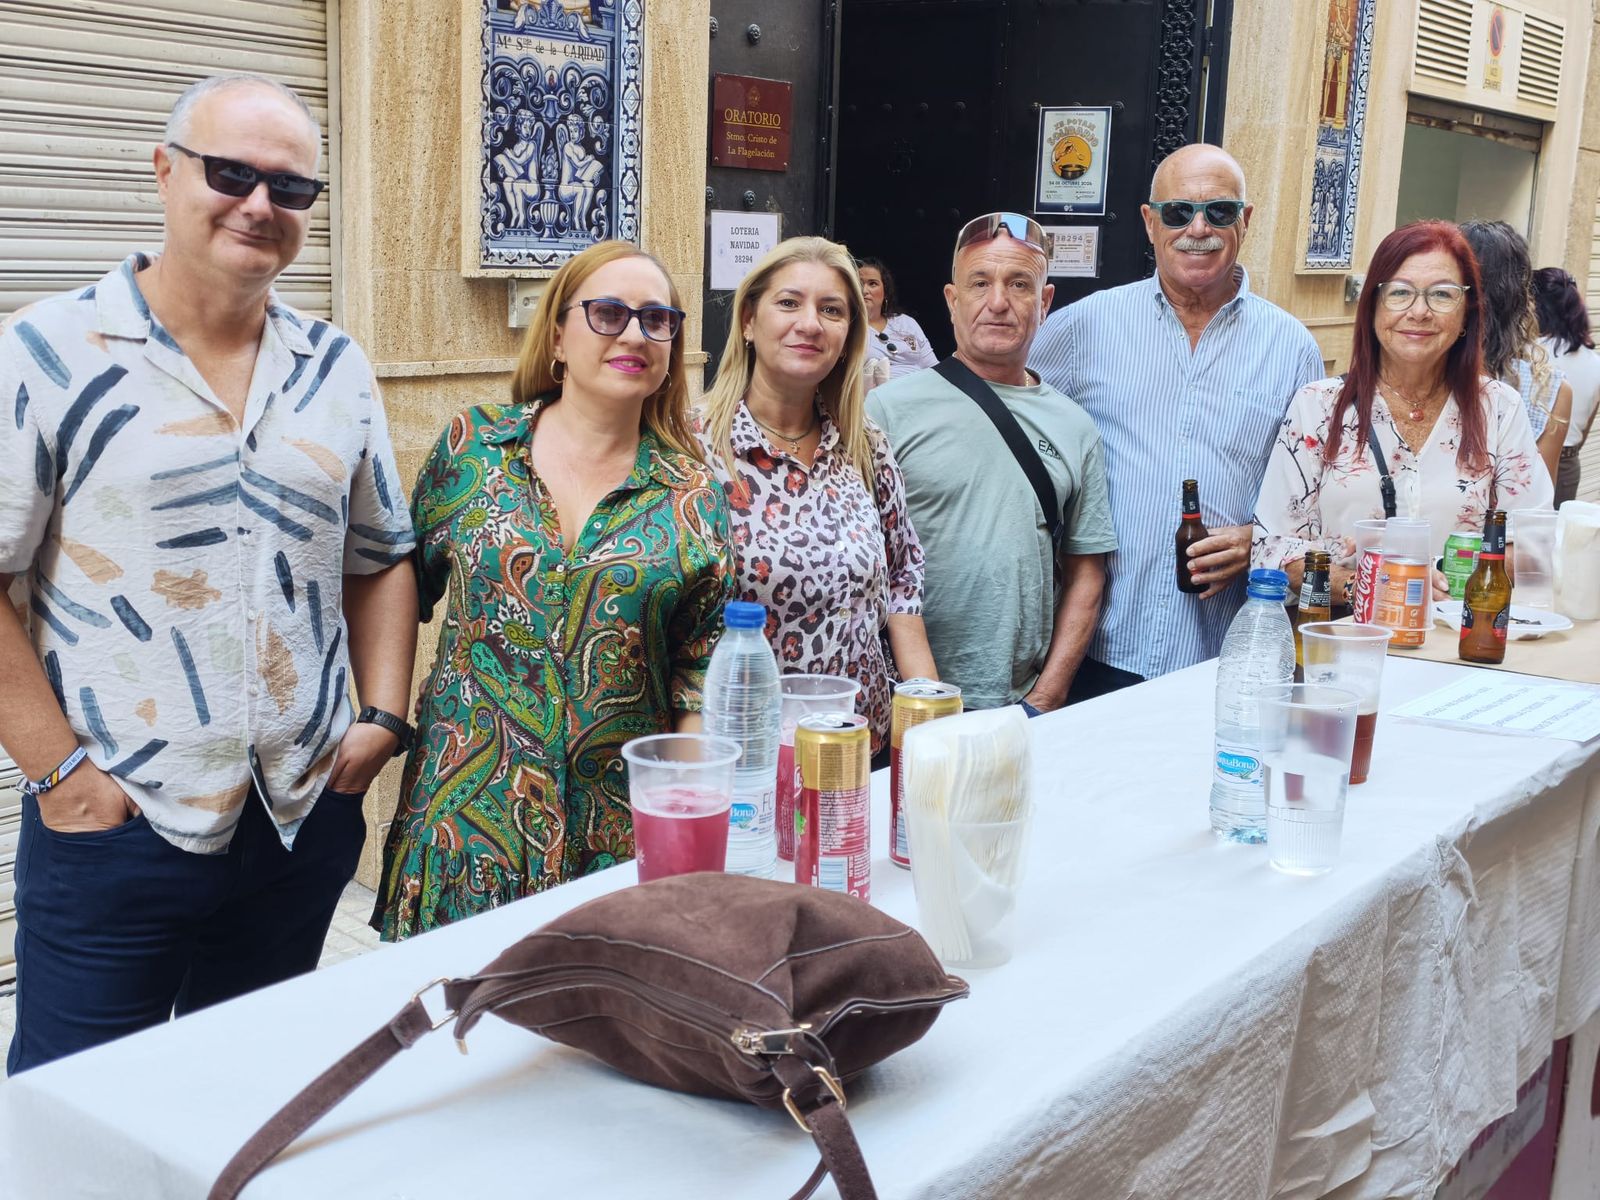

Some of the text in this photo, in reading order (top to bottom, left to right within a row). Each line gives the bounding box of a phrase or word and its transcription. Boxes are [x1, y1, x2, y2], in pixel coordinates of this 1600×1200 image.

[535, 40, 545, 54] de
[550, 43, 557, 56] la
[563, 44, 605, 62] CARIDAD
[724, 108, 781, 126] ORATORIO
[747, 133, 768, 143] Cristo
[768, 135, 778, 145] de
[727, 146, 775, 159] La Flagelación
[730, 226, 760, 236] LOTERIA
[730, 241, 760, 250] NAVIDAD
